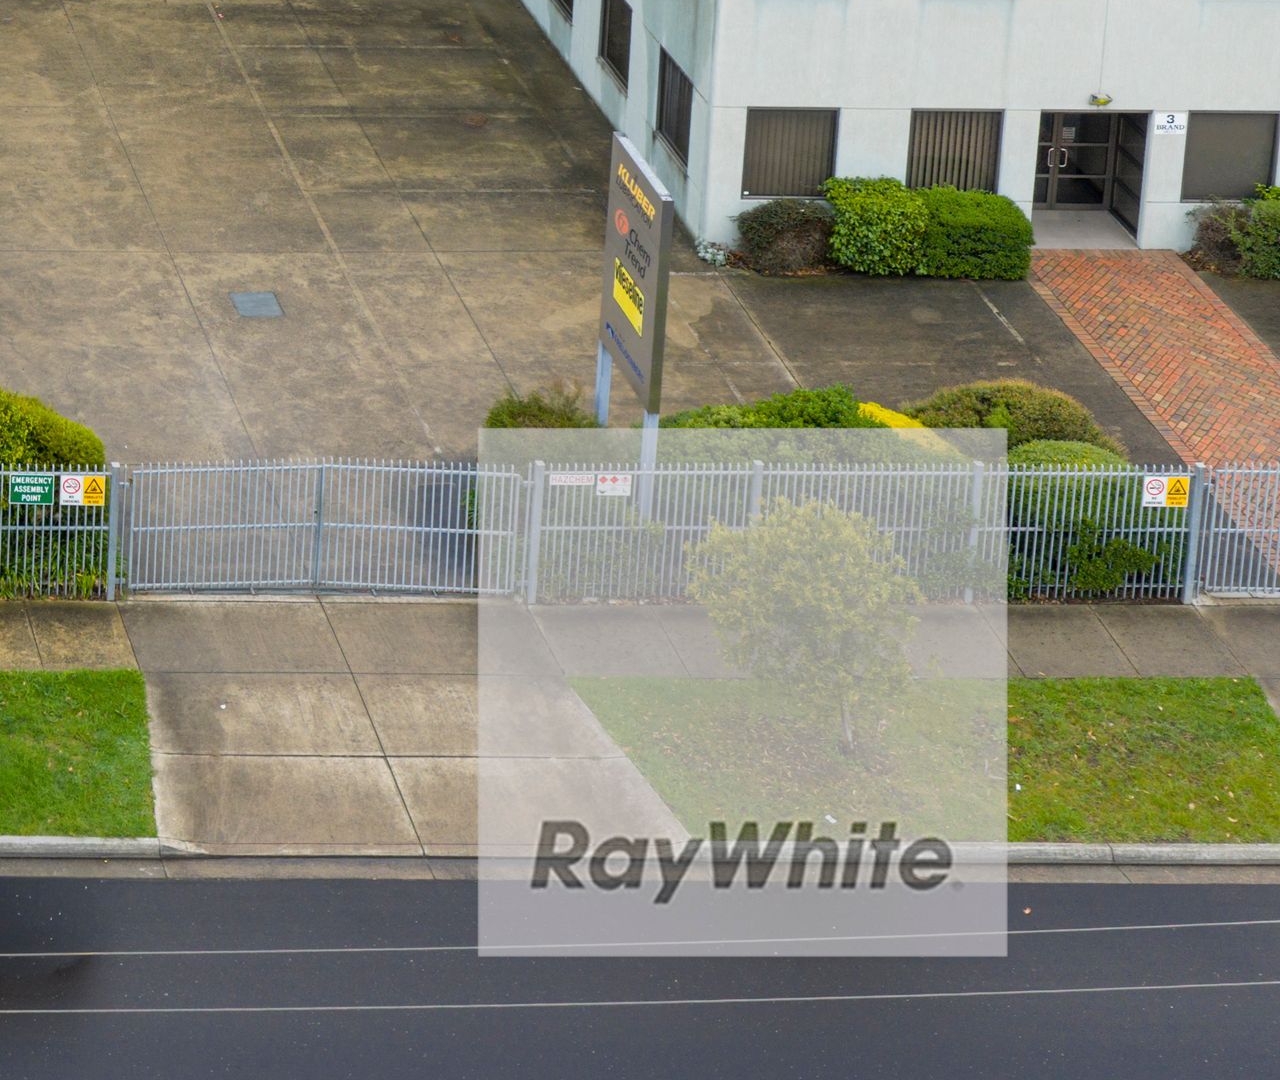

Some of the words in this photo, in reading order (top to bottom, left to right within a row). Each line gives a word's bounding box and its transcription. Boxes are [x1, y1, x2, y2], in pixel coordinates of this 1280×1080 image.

[1166, 114, 1175, 124] 3
[629, 228, 651, 268] Chem
[625, 238, 647, 279] Trend
[11, 476, 52, 484] EMERGENCY
[551, 475, 593, 484] HAZCHEM
[14, 485, 49, 493] ASSEMBLY
[21, 494, 42, 502] POINT
